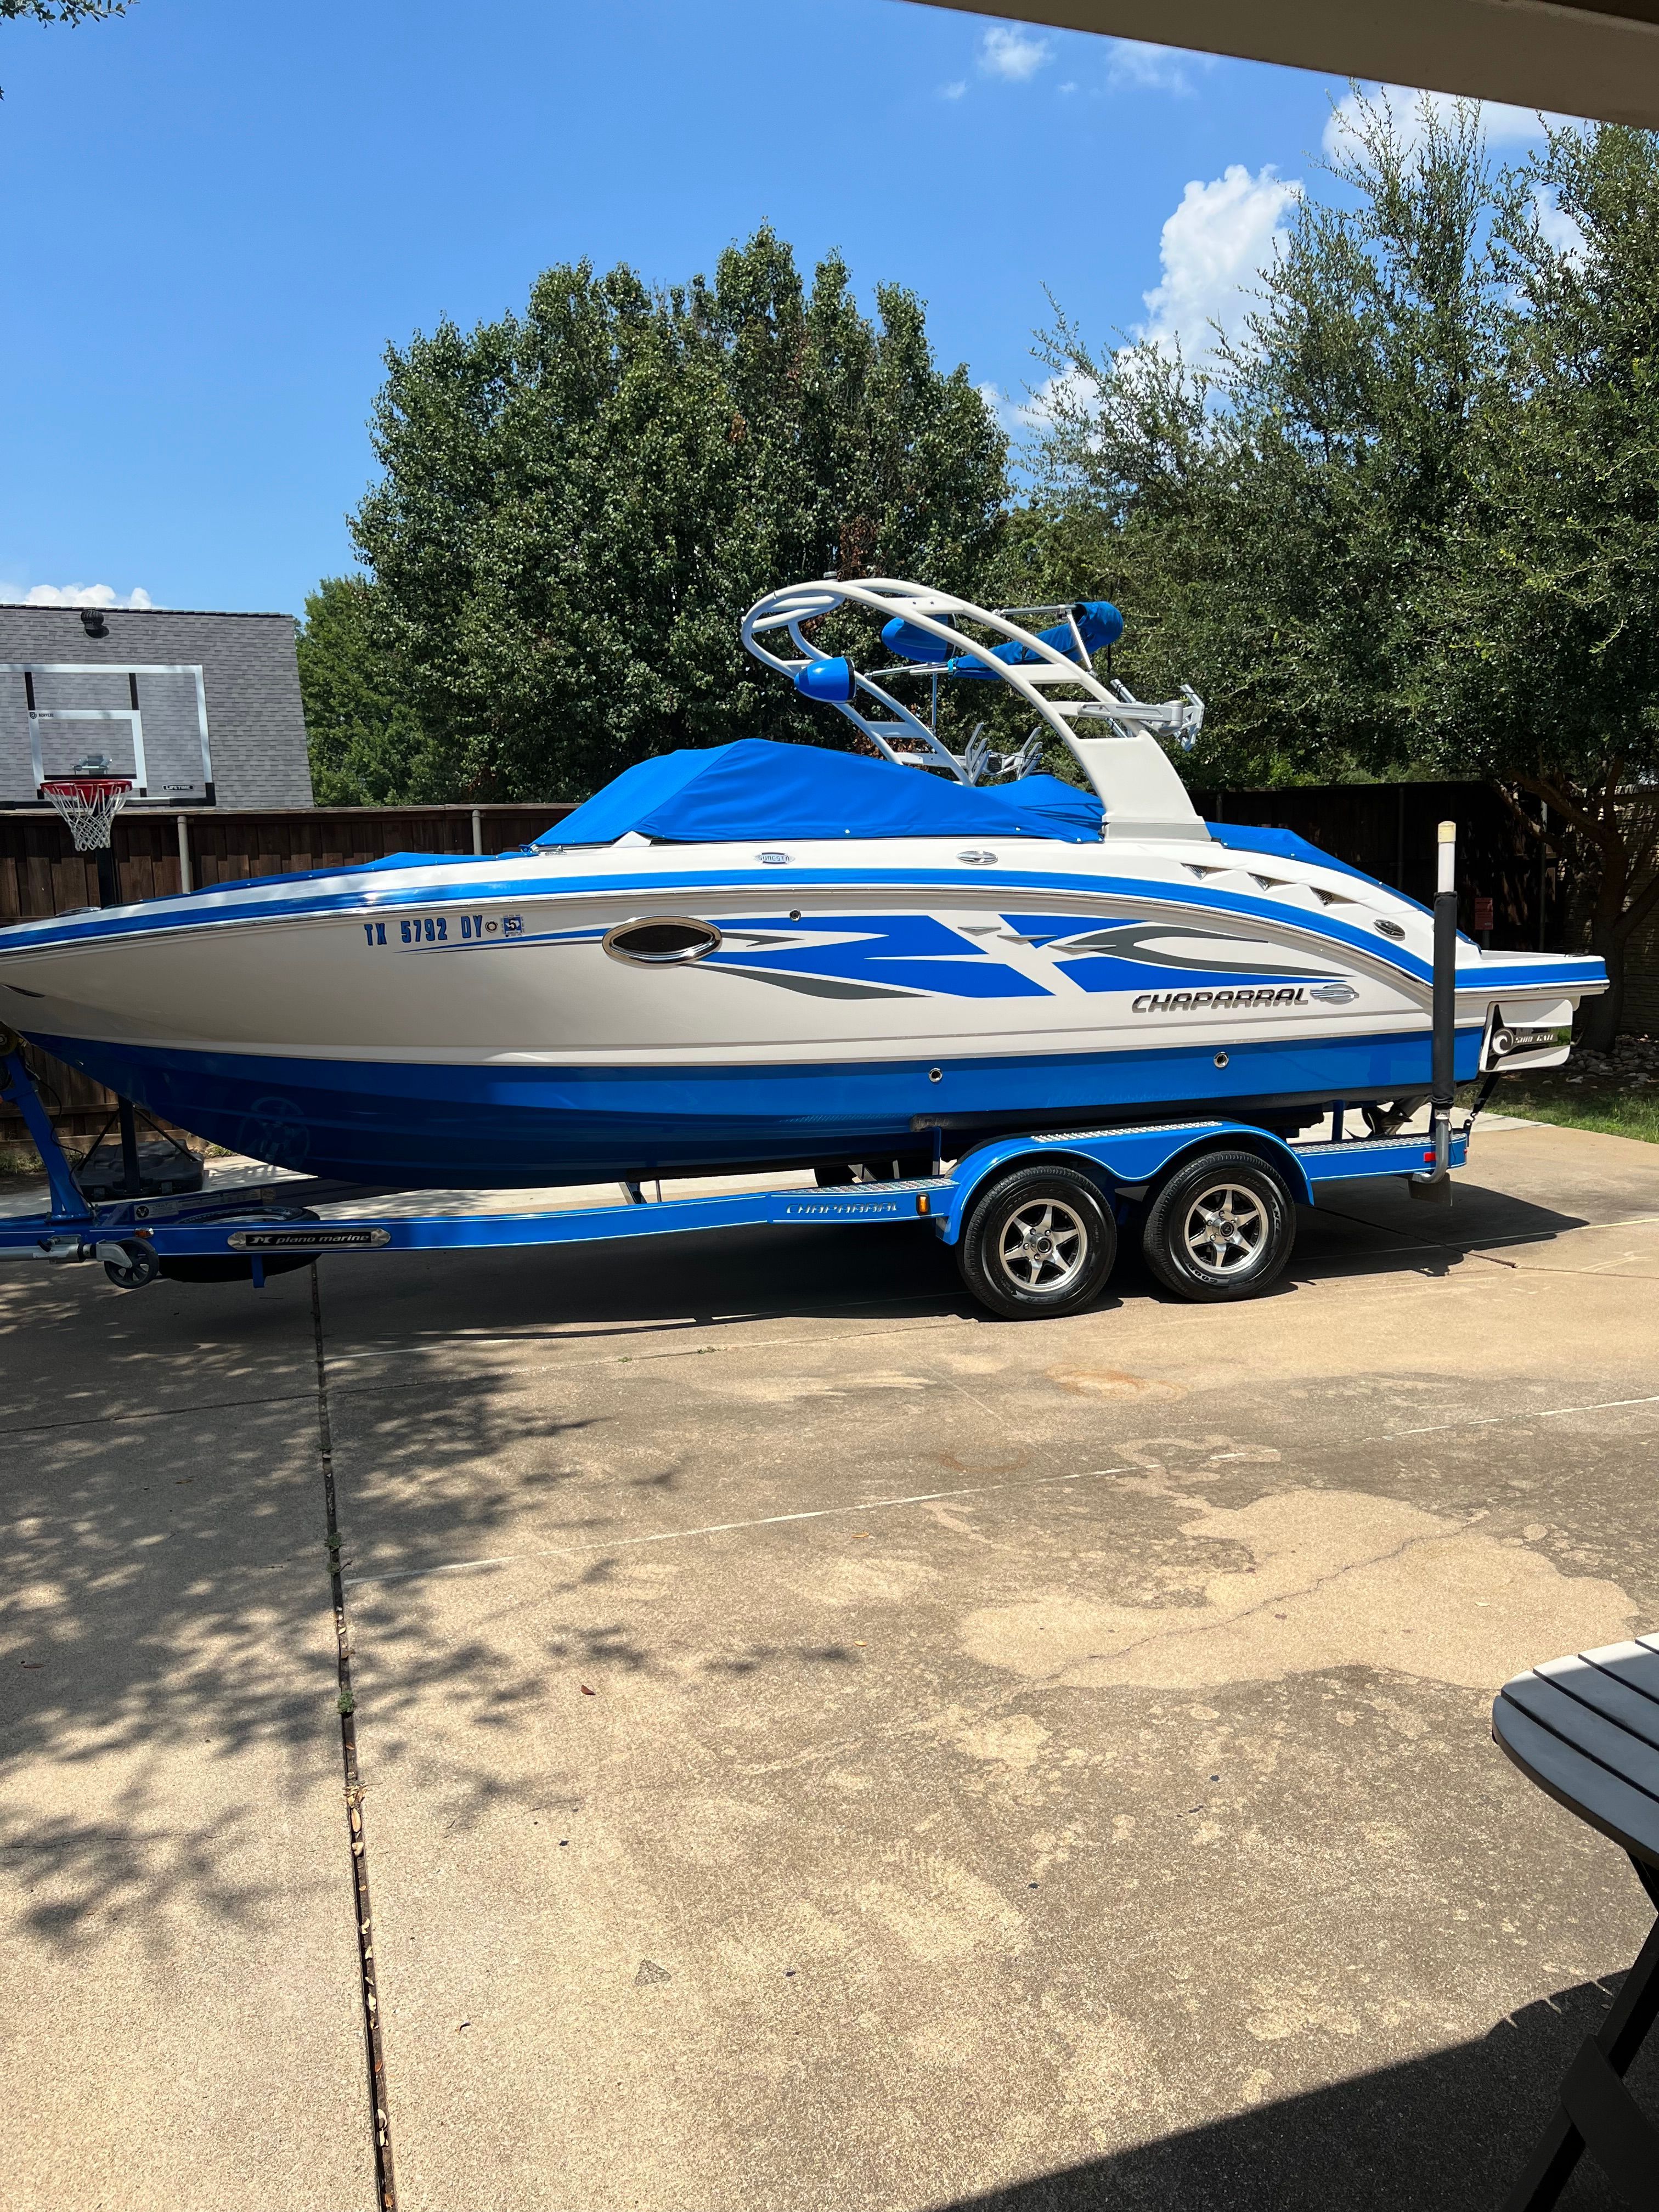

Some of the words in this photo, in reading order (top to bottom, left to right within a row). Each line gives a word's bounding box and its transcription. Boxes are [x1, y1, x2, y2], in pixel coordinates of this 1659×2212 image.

[364, 923, 387, 946] TX
[400, 917, 448, 943] 5792
[461, 915, 483, 939] DY
[1131, 988, 1308, 1013] CHAPARRAL
[786, 1201, 900, 1214] CHAPARRAL
